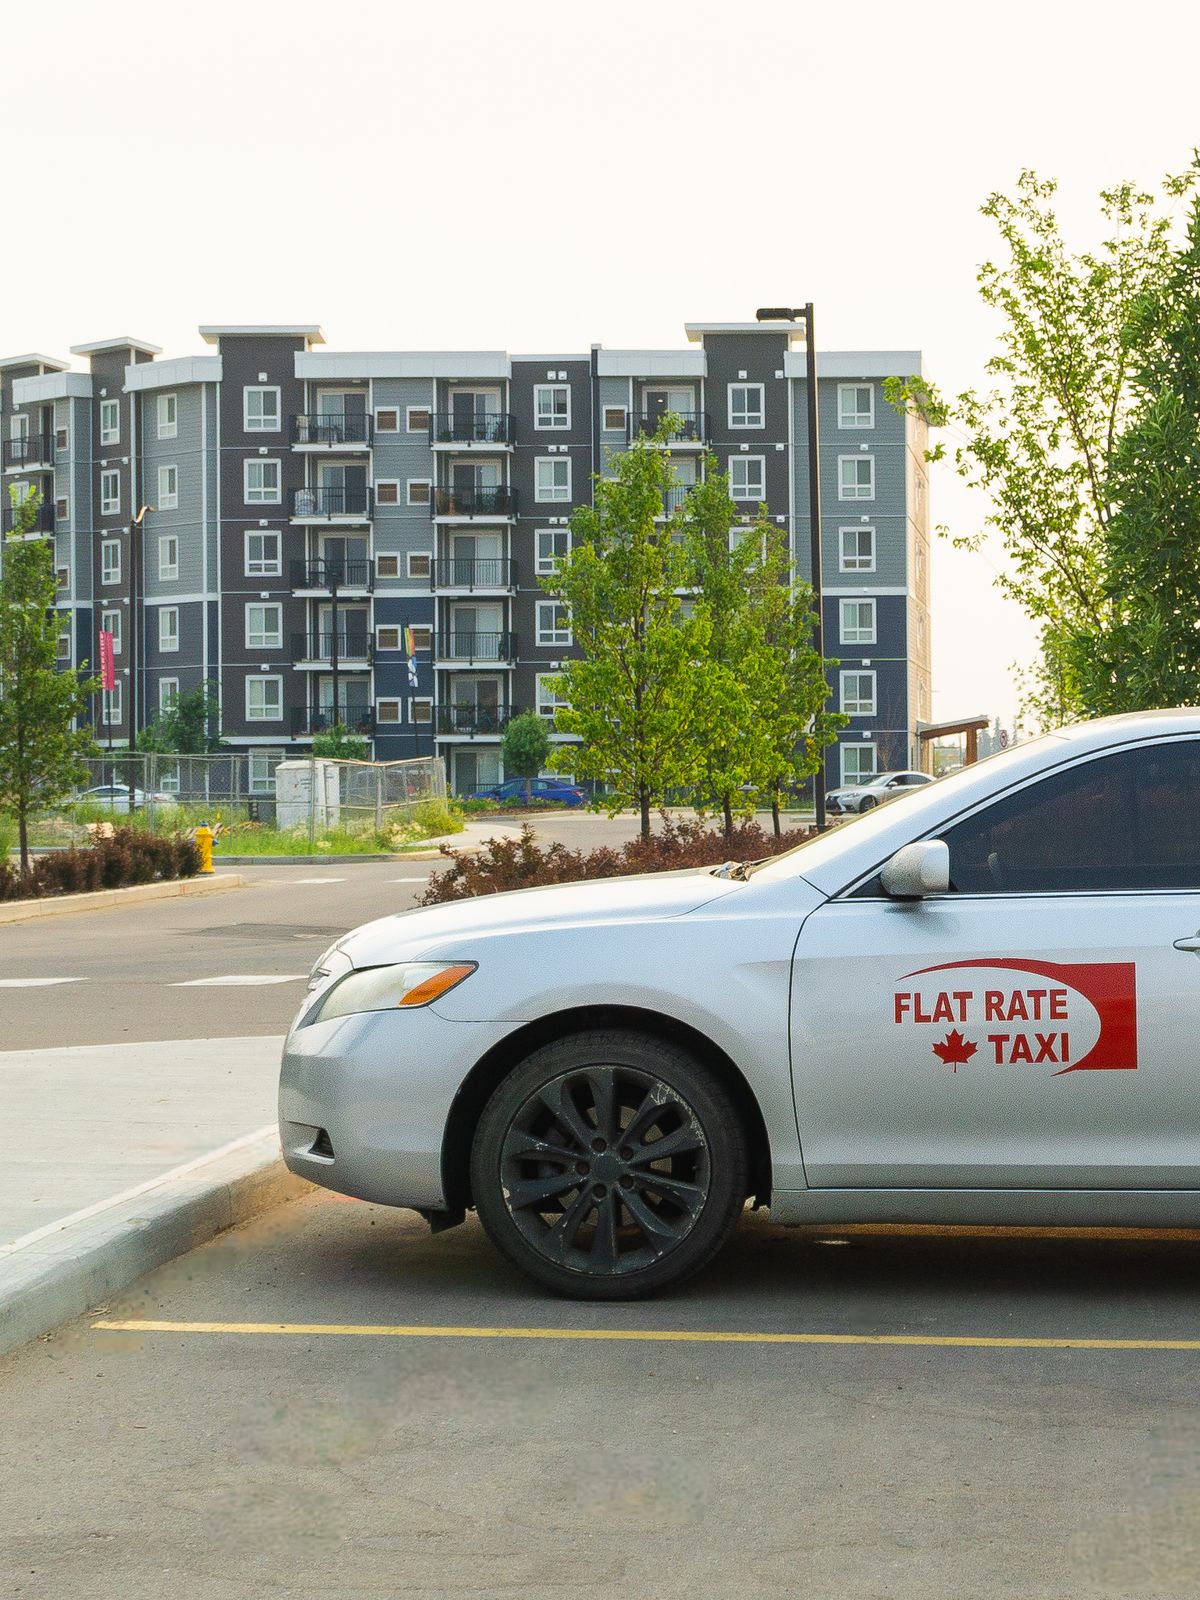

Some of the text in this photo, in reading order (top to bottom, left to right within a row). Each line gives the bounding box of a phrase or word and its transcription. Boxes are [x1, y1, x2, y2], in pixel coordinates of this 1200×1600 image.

[894, 988, 1069, 1024] FLAT RATE
[987, 1032, 1070, 1064] TAXI
